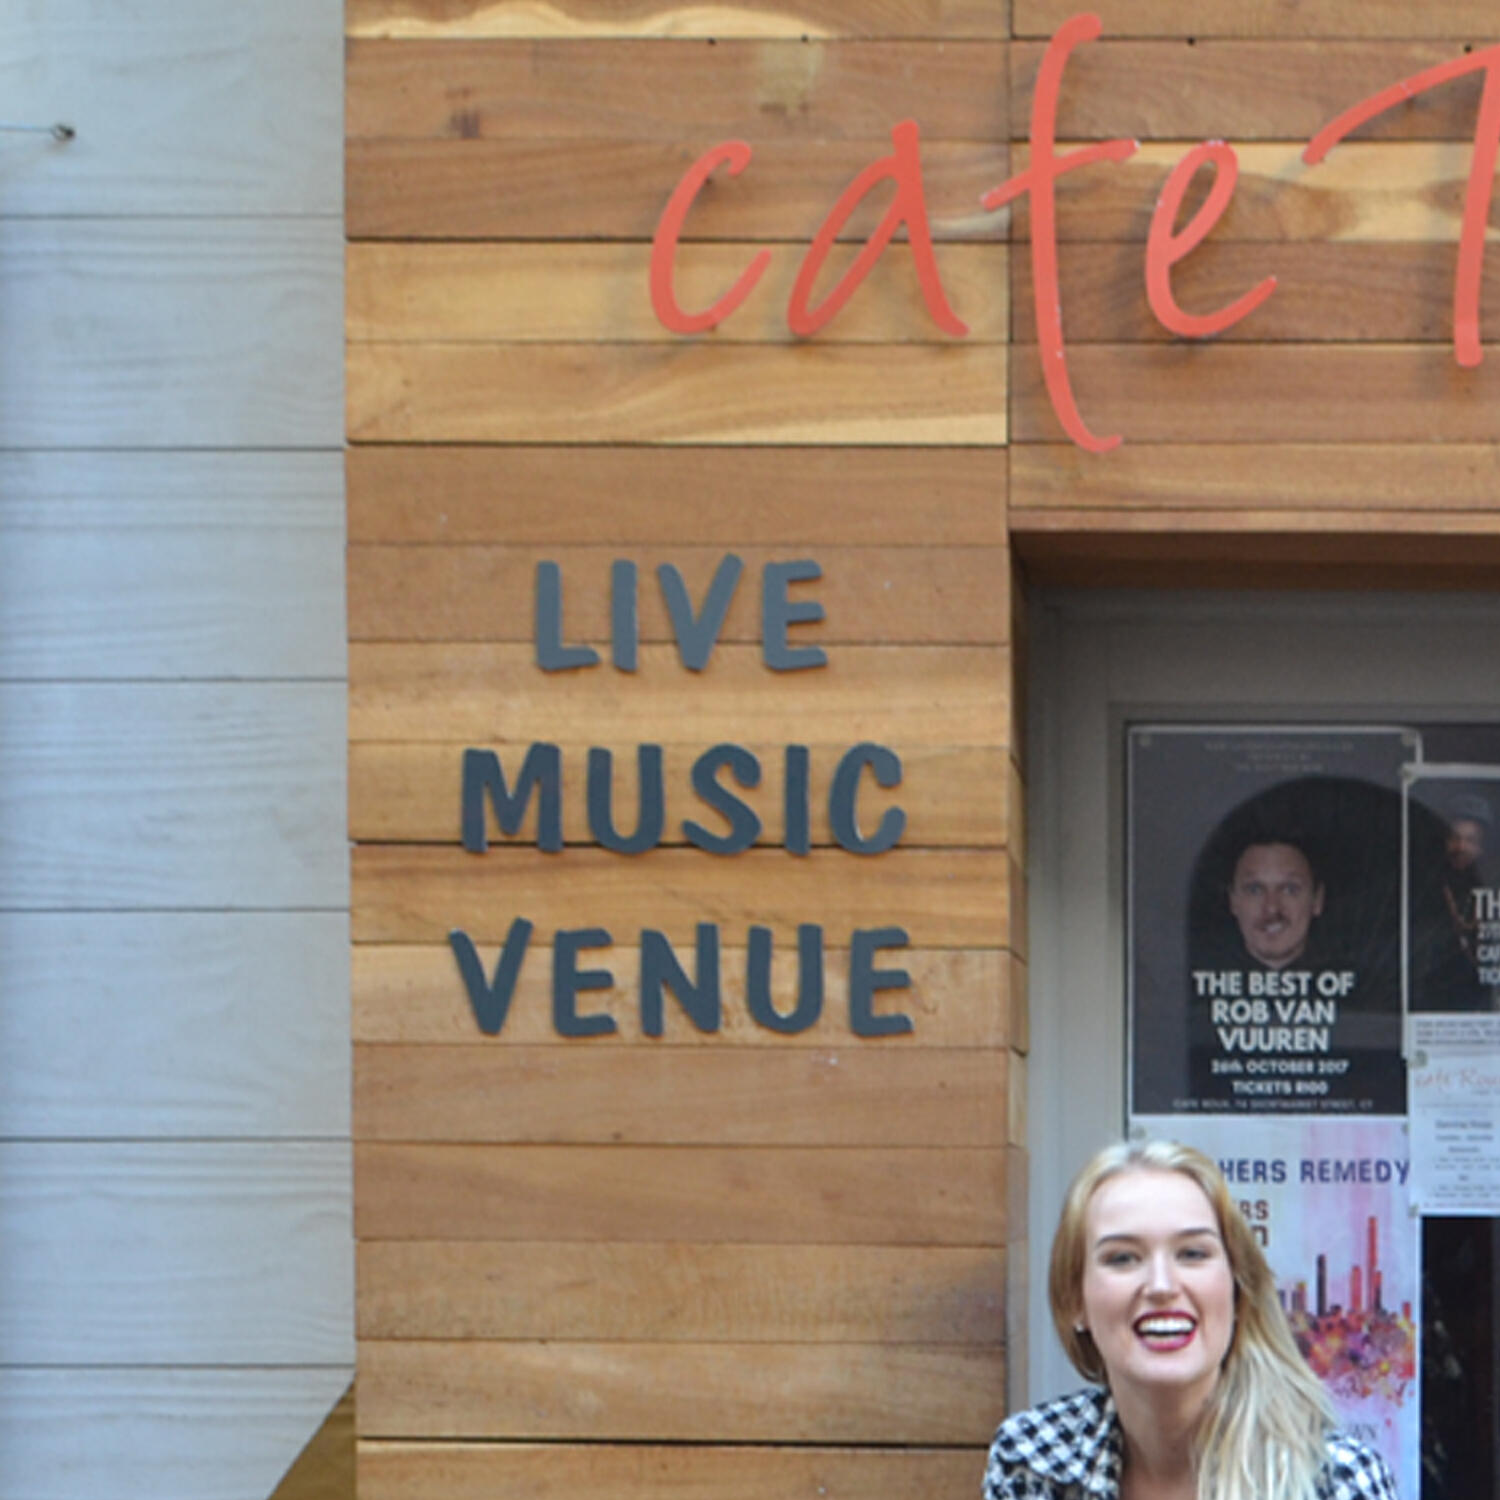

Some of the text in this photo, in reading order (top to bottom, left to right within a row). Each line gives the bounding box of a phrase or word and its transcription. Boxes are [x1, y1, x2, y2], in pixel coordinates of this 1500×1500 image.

[648, 13, 1277, 452] cafe
[535, 553, 828, 673] LIVE
[461, 741, 906, 856] MUSIC
[449, 917, 914, 1037] VENUE
[1192, 971, 1356, 997] THE BEST OF
[1211, 999, 1336, 1025] ROB VAN
[1217, 1027, 1330, 1052] VUUREN
[1219, 1158, 1287, 1184] HERS
[1300, 1159, 1410, 1185] REMEDY
